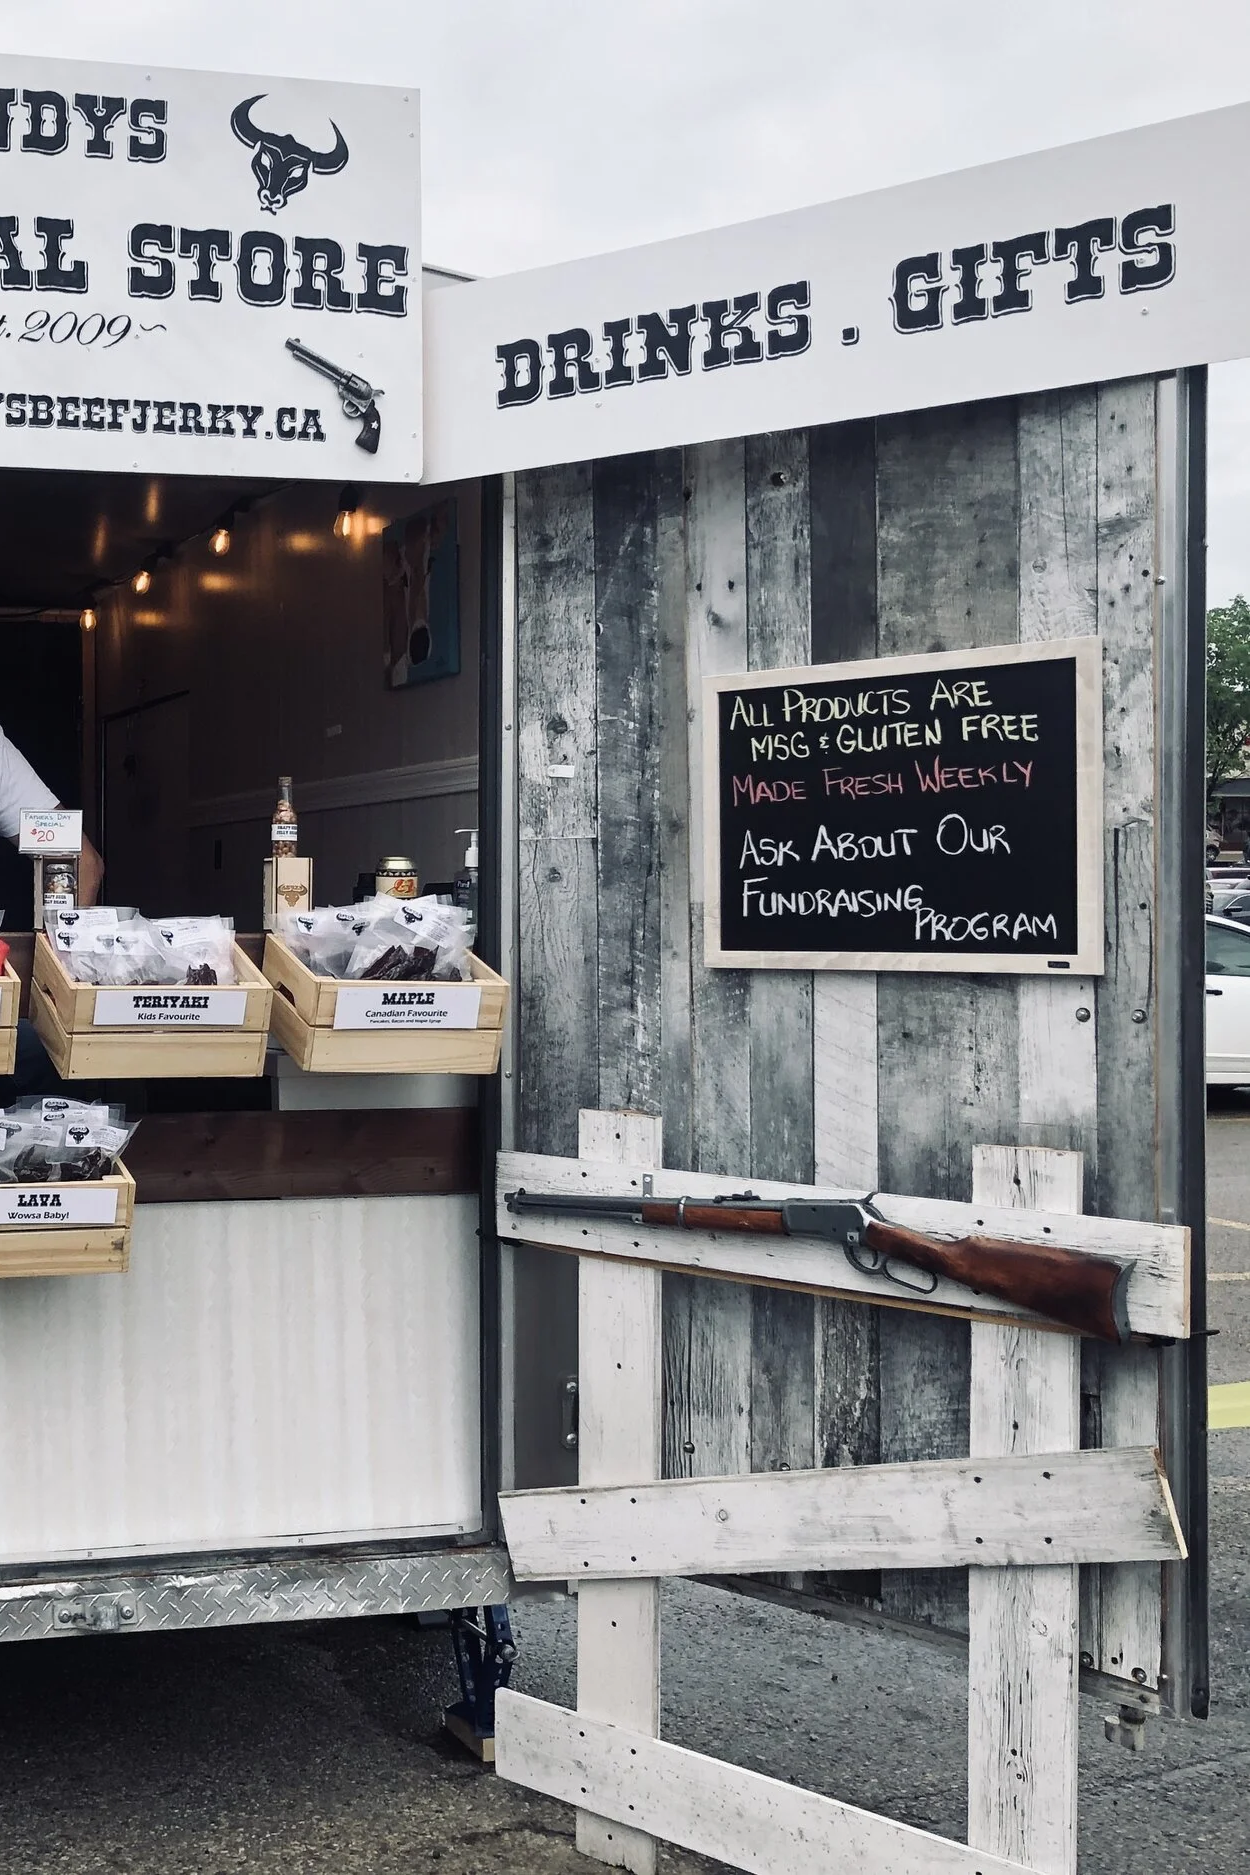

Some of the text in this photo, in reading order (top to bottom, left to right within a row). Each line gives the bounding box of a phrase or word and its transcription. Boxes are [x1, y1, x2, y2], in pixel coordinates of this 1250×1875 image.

[126, 222, 410, 319] STORE
[495, 279, 812, 409] DRINKS
[890, 202, 1177, 335] GIFTS
[729, 678, 993, 732] ALL PRODUCTS ARE
[750, 731, 811, 763] MSG
[835, 718, 943, 755] GLUTEN
[960, 713, 1040, 743] FREE
[732, 755, 1035, 808] MADE FRESH WEEKLY
[57, 812, 73, 820] DAY
[34, 820, 65, 828] SPECIAL
[30, 828, 56, 843] $20
[738, 812, 1012, 870] ASK ABOUT OUR
[741, 876, 924, 918] FUNDRAISING
[914, 906, 1058, 942] PROGRAM
[132, 995, 210, 1009] TERIYAKI
[381, 992, 435, 1005] MAPLE
[137, 1012, 201, 1021] Kids Favourite
[365, 1009, 448, 1018] Canadian Favourite
[17, 1194, 62, 1207] LAVA
[8, 1211, 70, 1221] Wowsa Baby!
